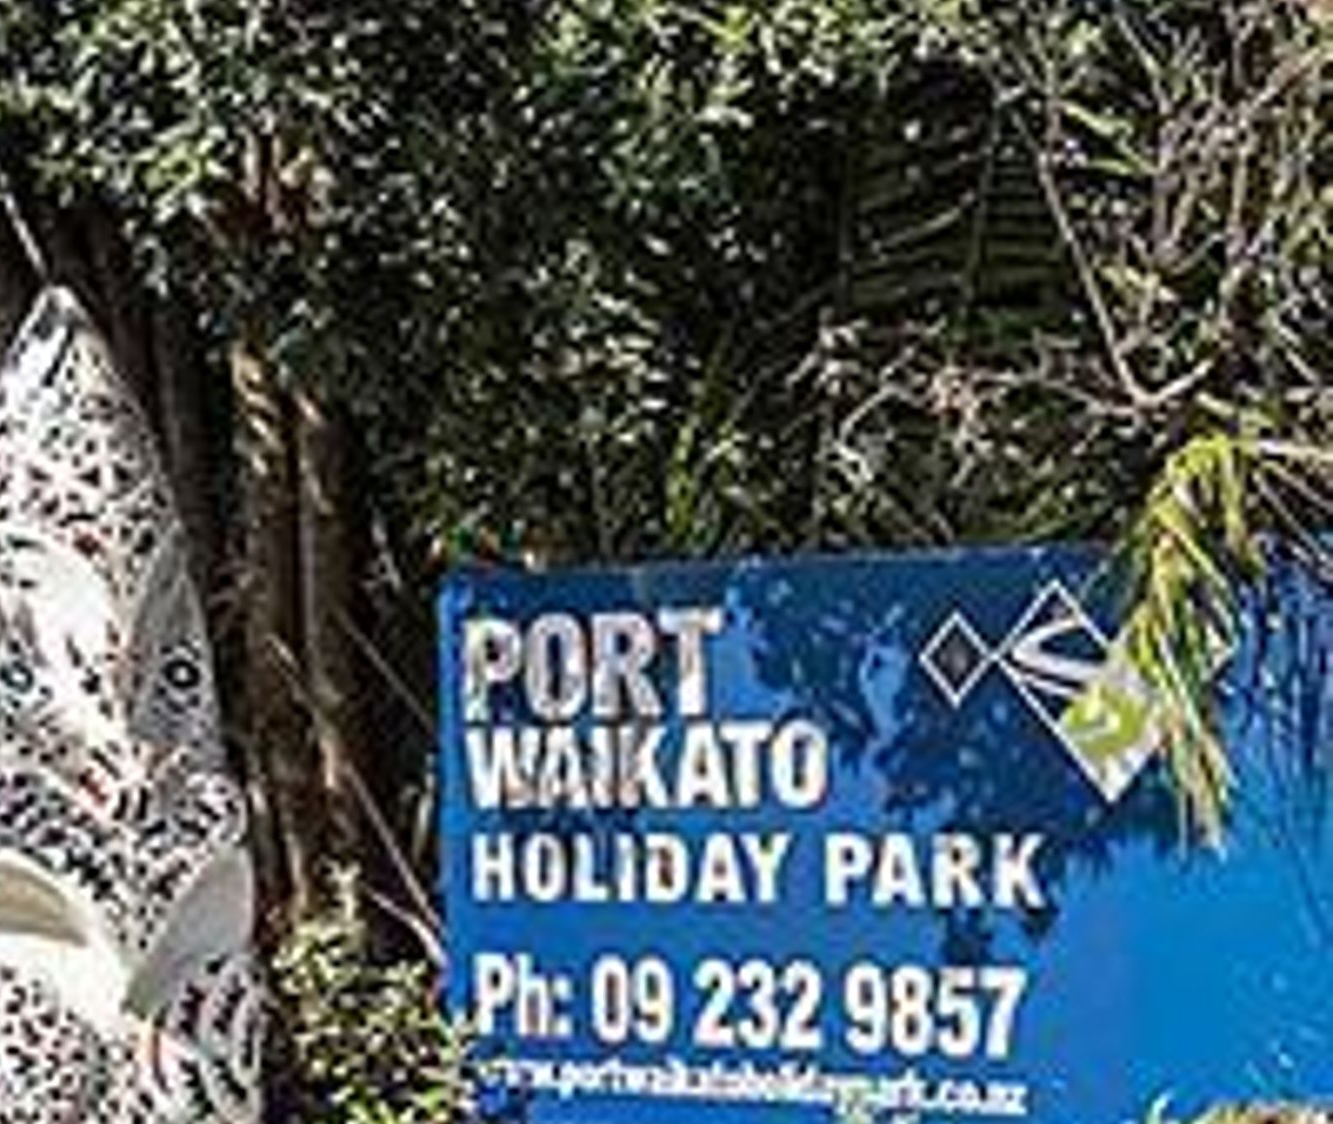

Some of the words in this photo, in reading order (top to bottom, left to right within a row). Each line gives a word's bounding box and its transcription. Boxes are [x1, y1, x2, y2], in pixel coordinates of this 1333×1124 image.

[463, 607, 722, 721] PORT
[465, 718, 828, 809] WAIKATO
[472, 832, 790, 902] HOLIDAY
[824, 833, 1047, 908] PARK
[474, 953, 571, 1038] Ph:
[591, 955, 673, 1043] 09
[693, 960, 821, 1050] 232
[844, 964, 1027, 1058] 9857
